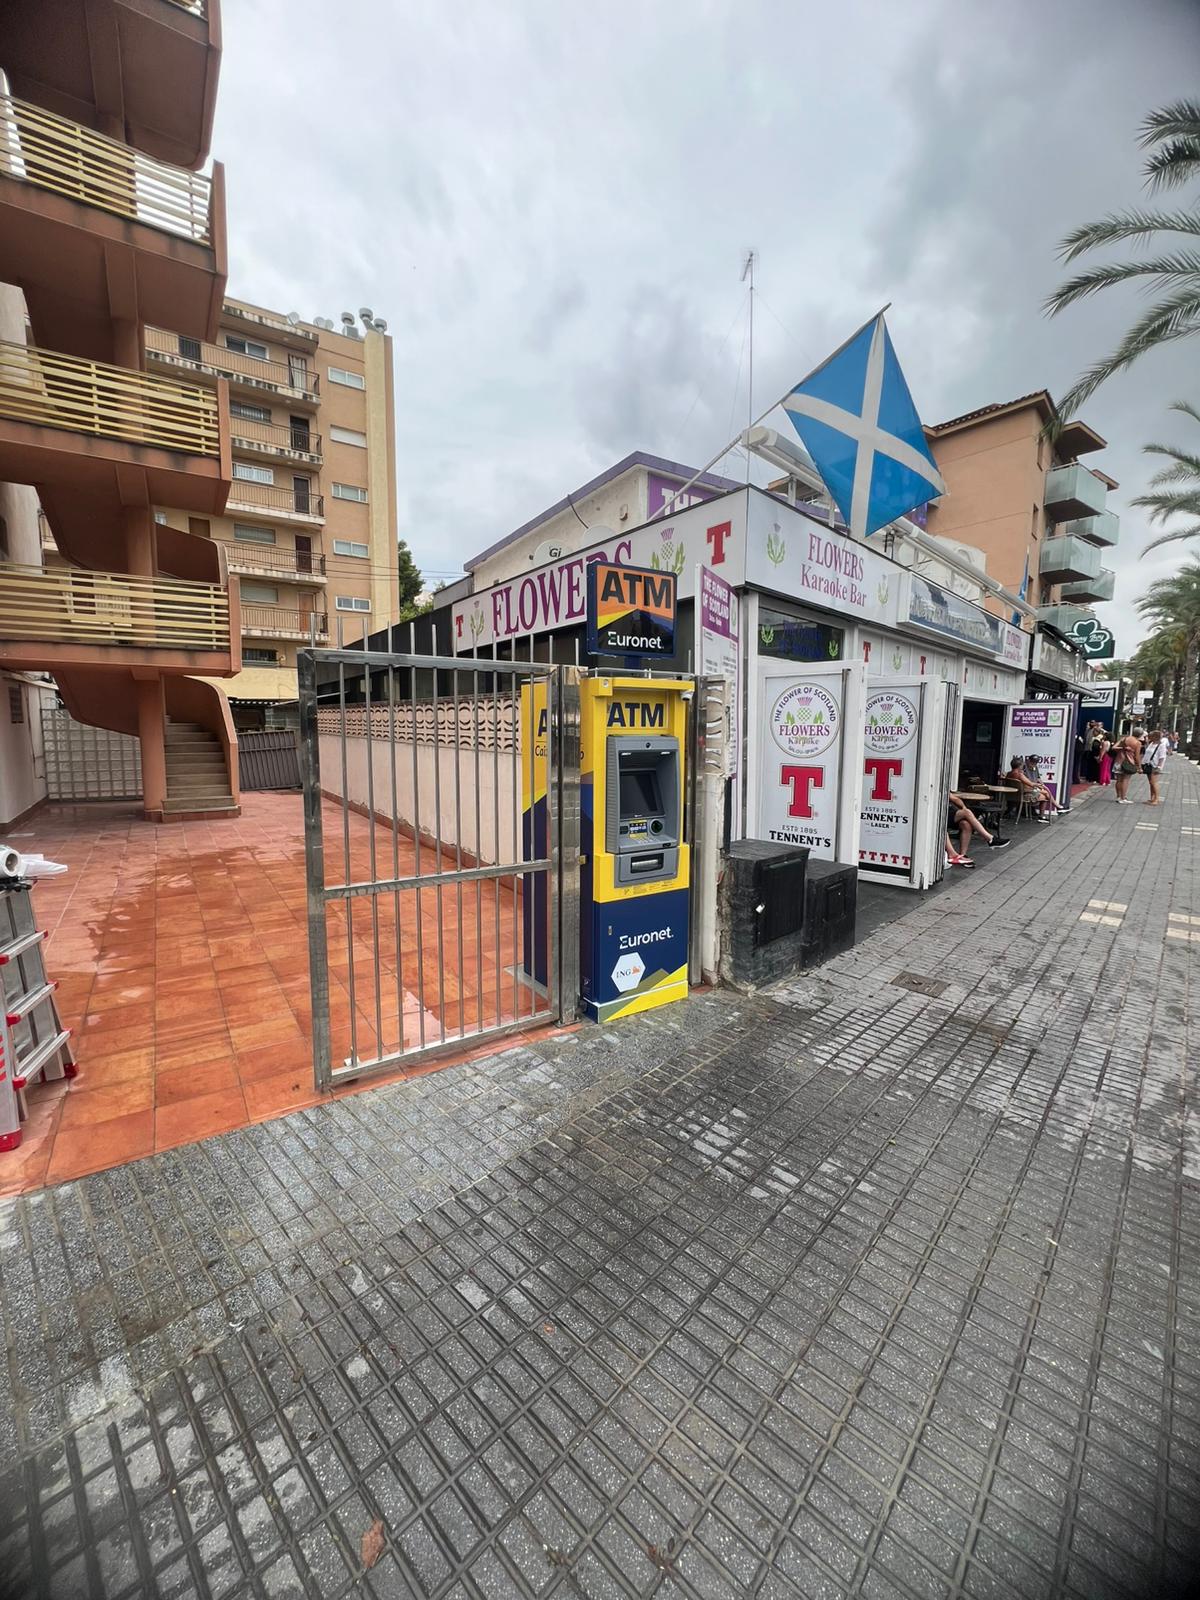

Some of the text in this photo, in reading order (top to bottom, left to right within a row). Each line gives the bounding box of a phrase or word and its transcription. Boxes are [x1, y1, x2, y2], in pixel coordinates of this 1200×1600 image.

[706, 521, 732, 566] T
[808, 533, 864, 582] FLOWERS
[491, 540, 632, 637] FLOWE
[601, 570, 672, 609] ATM
[801, 563, 867, 607] Karaoke Bar
[456, 614, 464, 638] T
[607, 631, 663, 649] Euronet
[863, 641, 871, 663] T
[920, 655, 927, 675] T
[607, 701, 664, 728] ATM
[774, 686, 836, 722] THE FLOWER OF SCOTLAND
[894, 697, 914, 724] SCOTLAND
[779, 724, 830, 737] FLOWERS
[864, 725, 909, 736] FLOWERS
[781, 765, 824, 818] T
[864, 758, 903, 801] T
[860, 812, 909, 824] ENNENT'S
[769, 830, 831, 848] TENNENT'S
[619, 926, 672, 950] Euronet
[616, 968, 632, 979] ING
